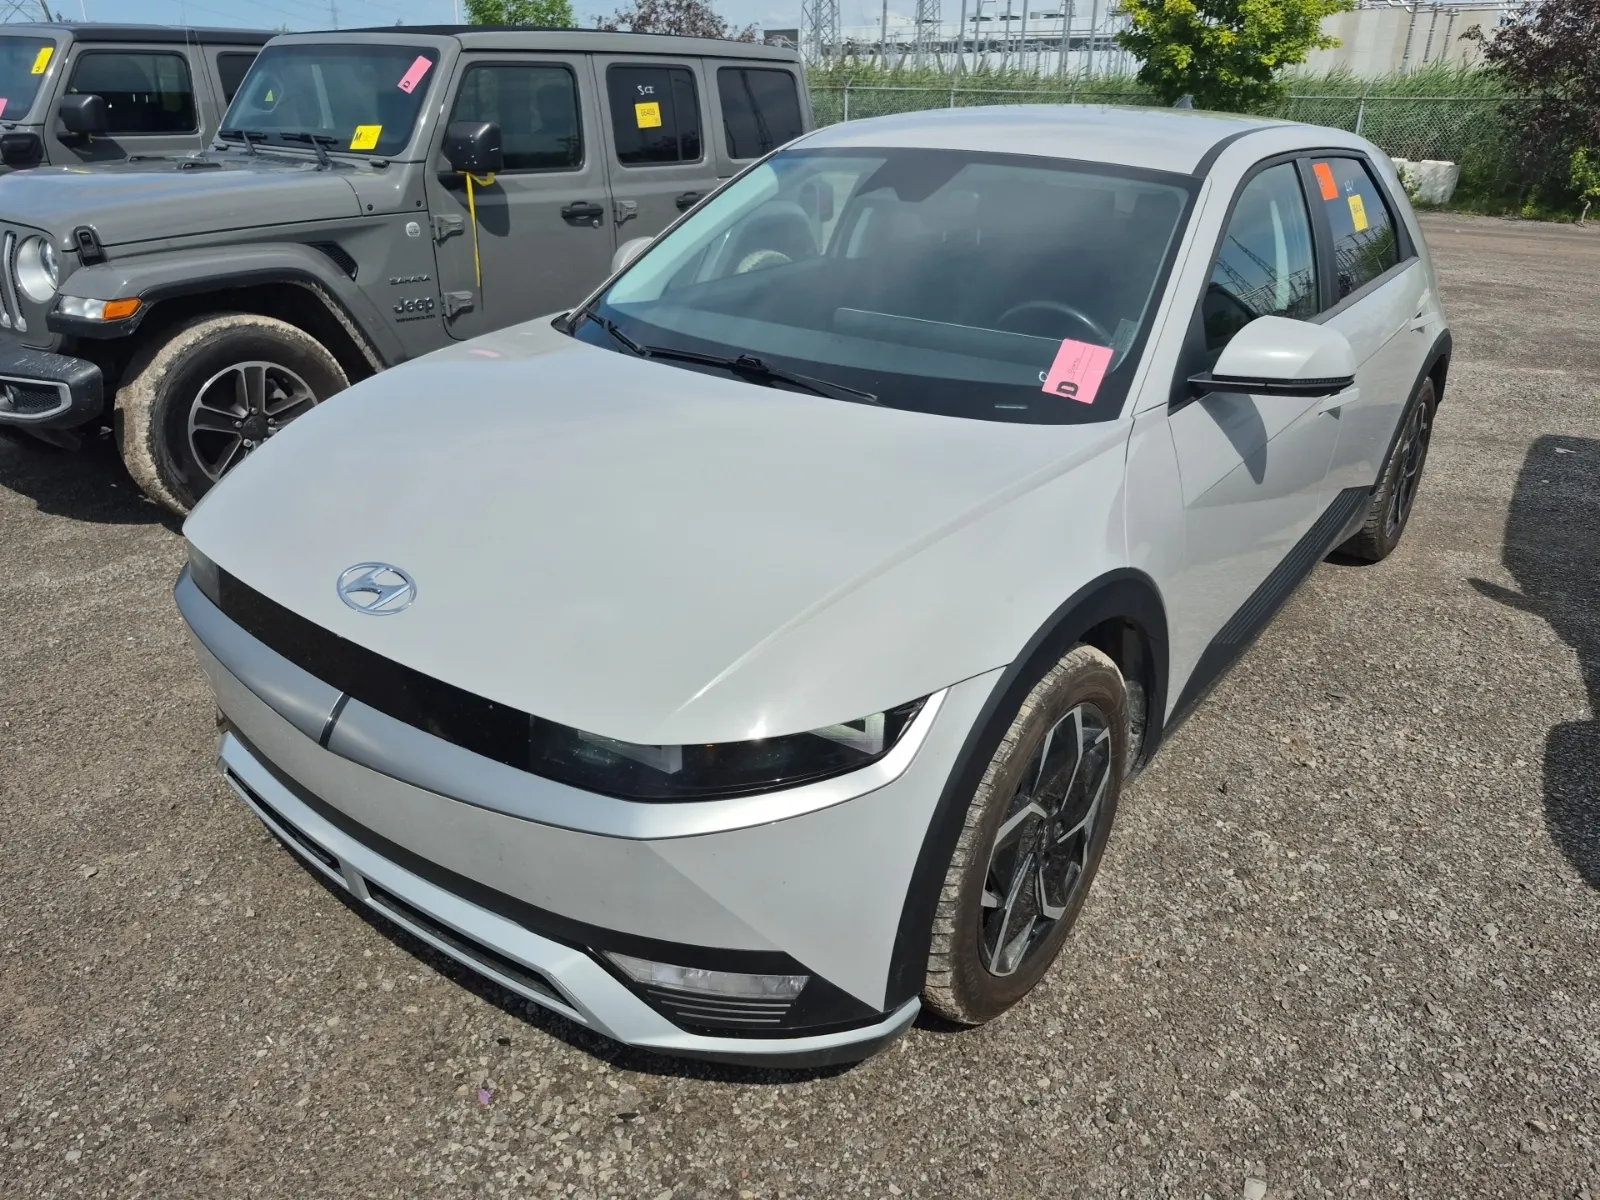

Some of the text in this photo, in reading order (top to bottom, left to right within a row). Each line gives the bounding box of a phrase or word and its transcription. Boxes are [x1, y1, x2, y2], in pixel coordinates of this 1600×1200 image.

[390, 275, 431, 285] SAHARA
[393, 297, 435, 314] Jeep
[1056, 381, 1079, 397] D
